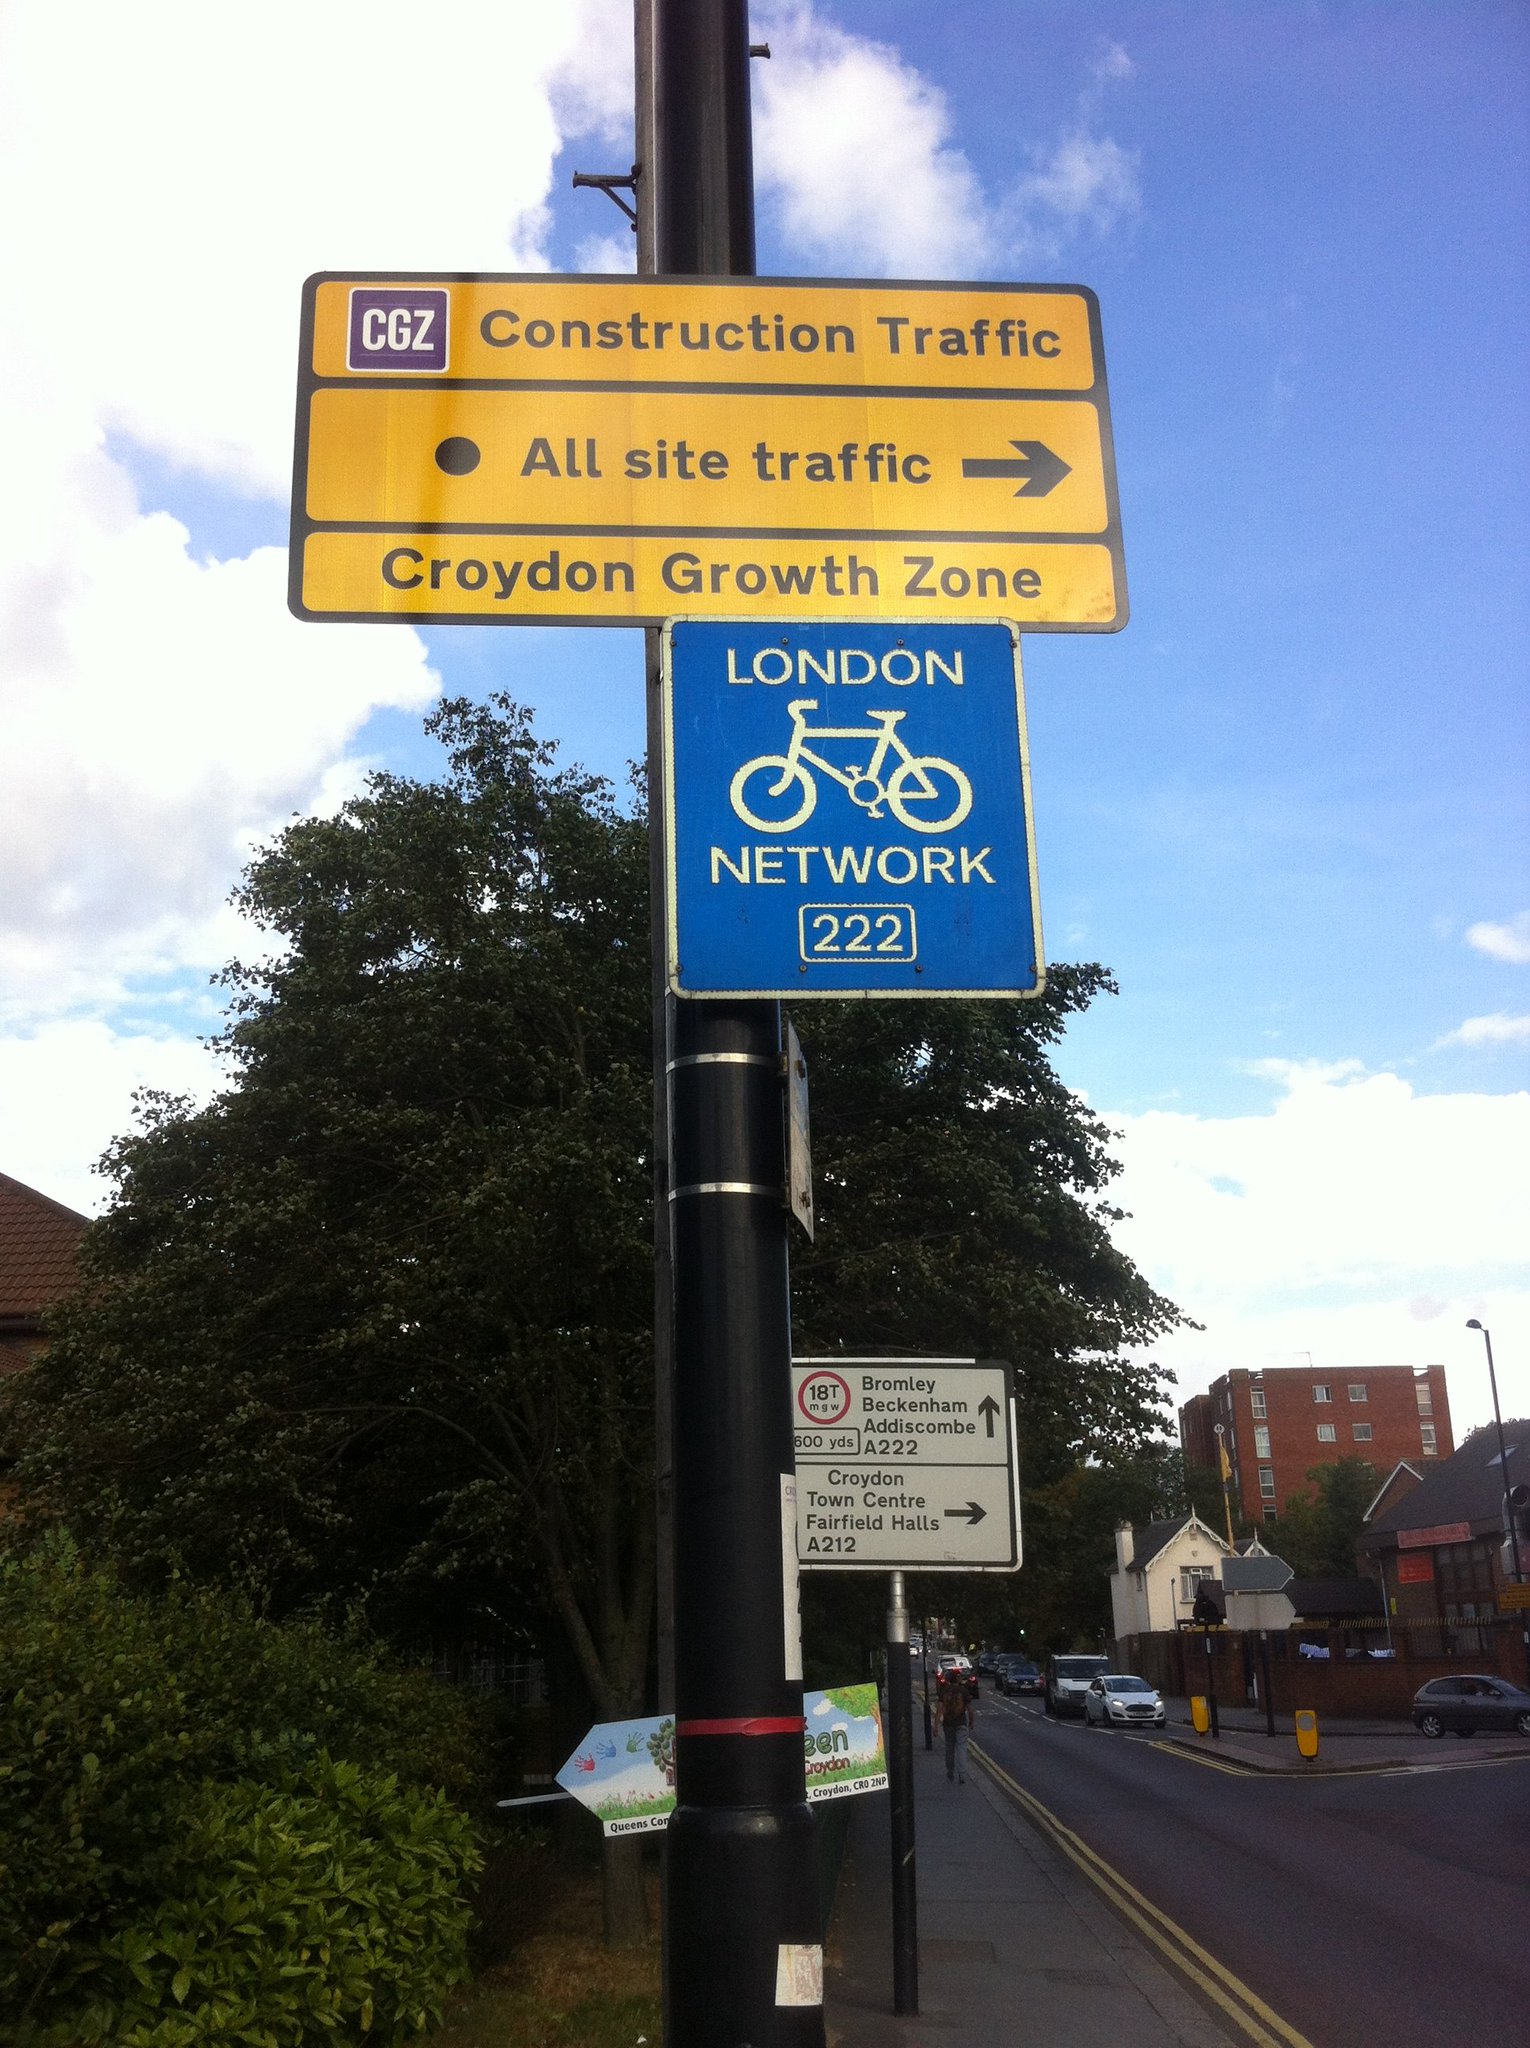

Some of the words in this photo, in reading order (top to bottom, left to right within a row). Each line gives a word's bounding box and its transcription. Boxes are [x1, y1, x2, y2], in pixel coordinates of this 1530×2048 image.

[363, 308, 435, 351] CGZ
[480, 309, 855, 354] Construction
[877, 316, 1062, 359] Traffic
[521, 438, 602, 478] All
[624, 440, 728, 480] site
[753, 442, 932, 484] traffic
[382, 548, 634, 600] Croydon
[662, 552, 879, 597] Growth
[904, 556, 1042, 599] Zone
[727, 647, 964, 686] LONDON
[710, 846, 996, 885] NETWORK
[812, 913, 904, 952] 222
[809, 1384, 840, 1401] 18T
[862, 1376, 936, 1394] Bromley
[862, 1397, 968, 1413] Beckenham
[864, 1418, 976, 1434] Addiscombe
[829, 1435, 854, 1450] yds
[864, 1439, 918, 1455] A222
[828, 1470, 904, 1488] Croydon
[806, 1491, 854, 1507] Town
[863, 1492, 926, 1508] Centre
[806, 1514, 883, 1531] Fairfield
[892, 1515, 940, 1531] Halls
[807, 1536, 856, 1552] A212
[813, 1785, 852, 1797] Croydon,
[610, 1820, 648, 1833] Queens
